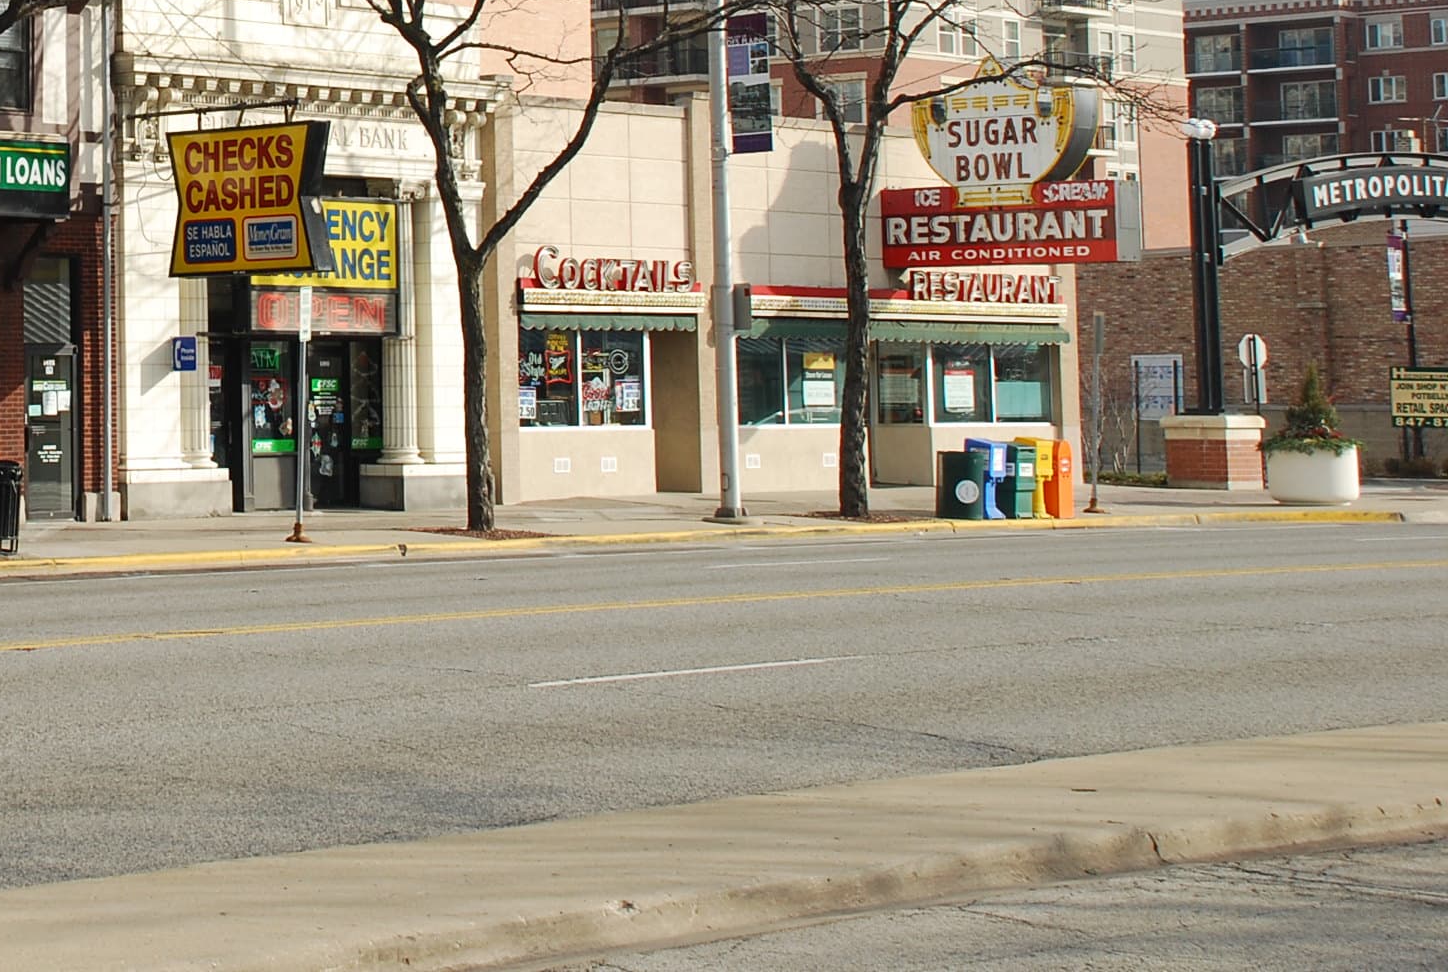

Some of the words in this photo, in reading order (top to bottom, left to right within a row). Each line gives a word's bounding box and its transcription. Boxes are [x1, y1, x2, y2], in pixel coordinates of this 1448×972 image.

[359, 127, 408, 150] BANK
[947, 116, 1038, 148] SUGAR
[184, 134, 295, 176] CHECKS
[955, 151, 1031, 181] BOWL
[6, 156, 67, 188] LOANS
[185, 174, 295, 214] CASHED
[914, 189, 941, 207] ICE
[1312, 174, 1448, 208] METROPOLIT
[187, 226, 199, 241] SE
[202, 224, 233, 240] HABLA
[326, 209, 390, 243] ENCY
[886, 209, 1109, 245] RESTAURANT
[189, 239, 231, 259] ESPAÑOL
[907, 250, 942, 261] AIR
[950, 246, 1091, 261] CONDITIONED
[533, 244, 696, 293] COCKTAILS
[911, 270, 1062, 304] RESTAURANT
[257, 292, 386, 331] OPEN
[251, 351, 278, 369] ATM
[1394, 383, 1414, 391] JOIN
[1416, 382, 1437, 391] SHOP
[1395, 402, 1427, 414] RETAIL
